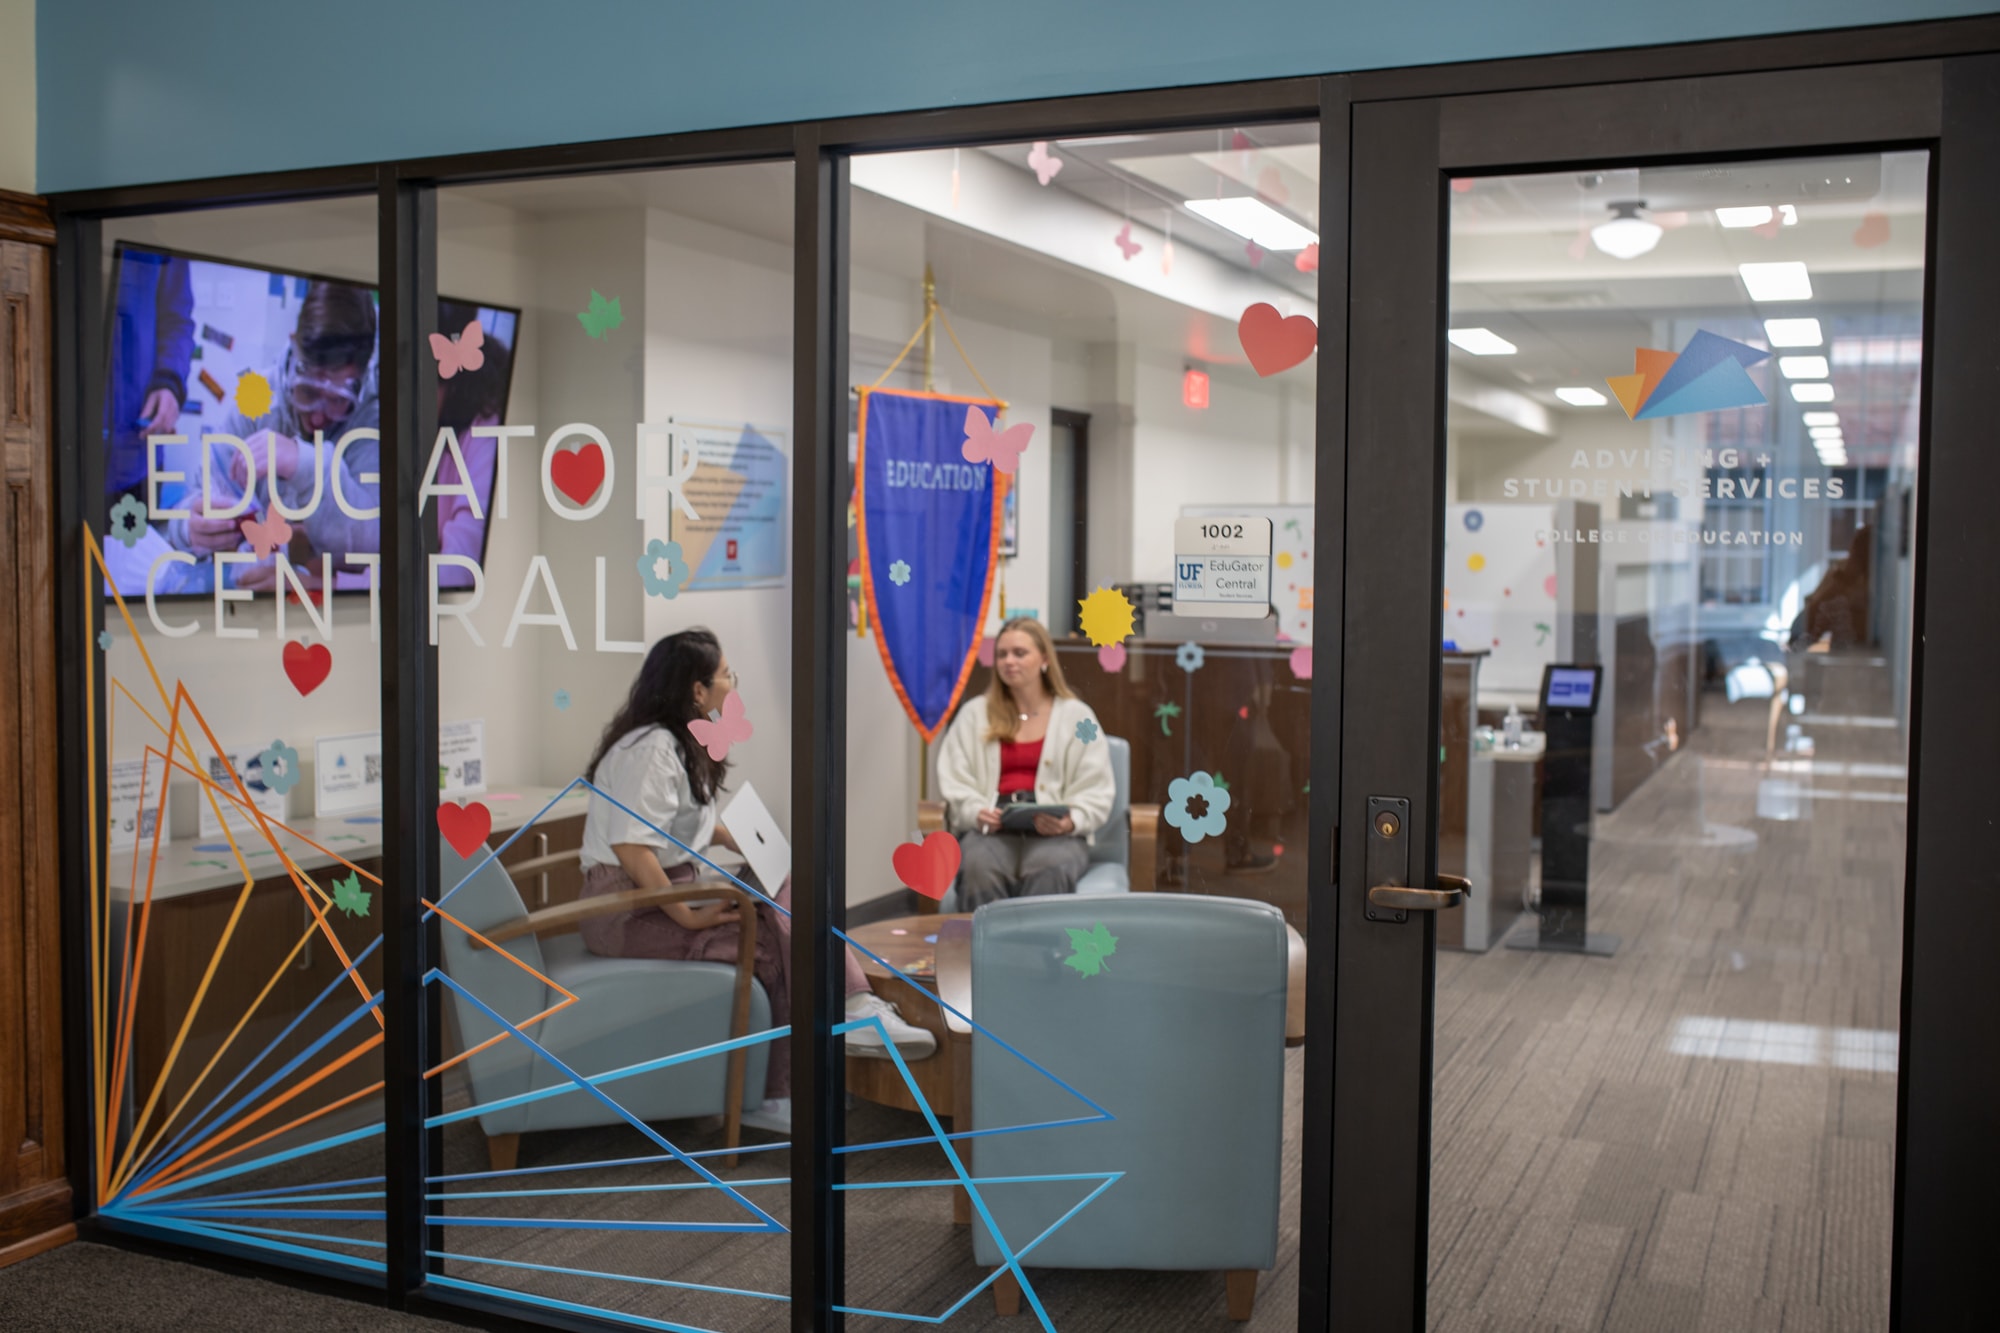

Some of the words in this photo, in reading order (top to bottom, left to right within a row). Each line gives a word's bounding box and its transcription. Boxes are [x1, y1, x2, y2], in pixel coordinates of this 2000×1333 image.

[1570, 448, 1739, 469] ADVISING
[147, 422, 700, 521] EDUGATOR
[886, 459, 987, 491] EDUCATION
[1503, 478, 1652, 499] STUDENT
[1672, 477, 1845, 499] SERVICES
[1200, 524, 1244, 539] 1002
[1535, 529, 1629, 544] COLLEGE
[1673, 530, 1804, 545] EDUCATION
[1178, 563, 1204, 581] UF
[1209, 559, 1264, 572] EduGator
[1215, 577, 1257, 590] Central
[145, 551, 645, 653] CENTRAL
